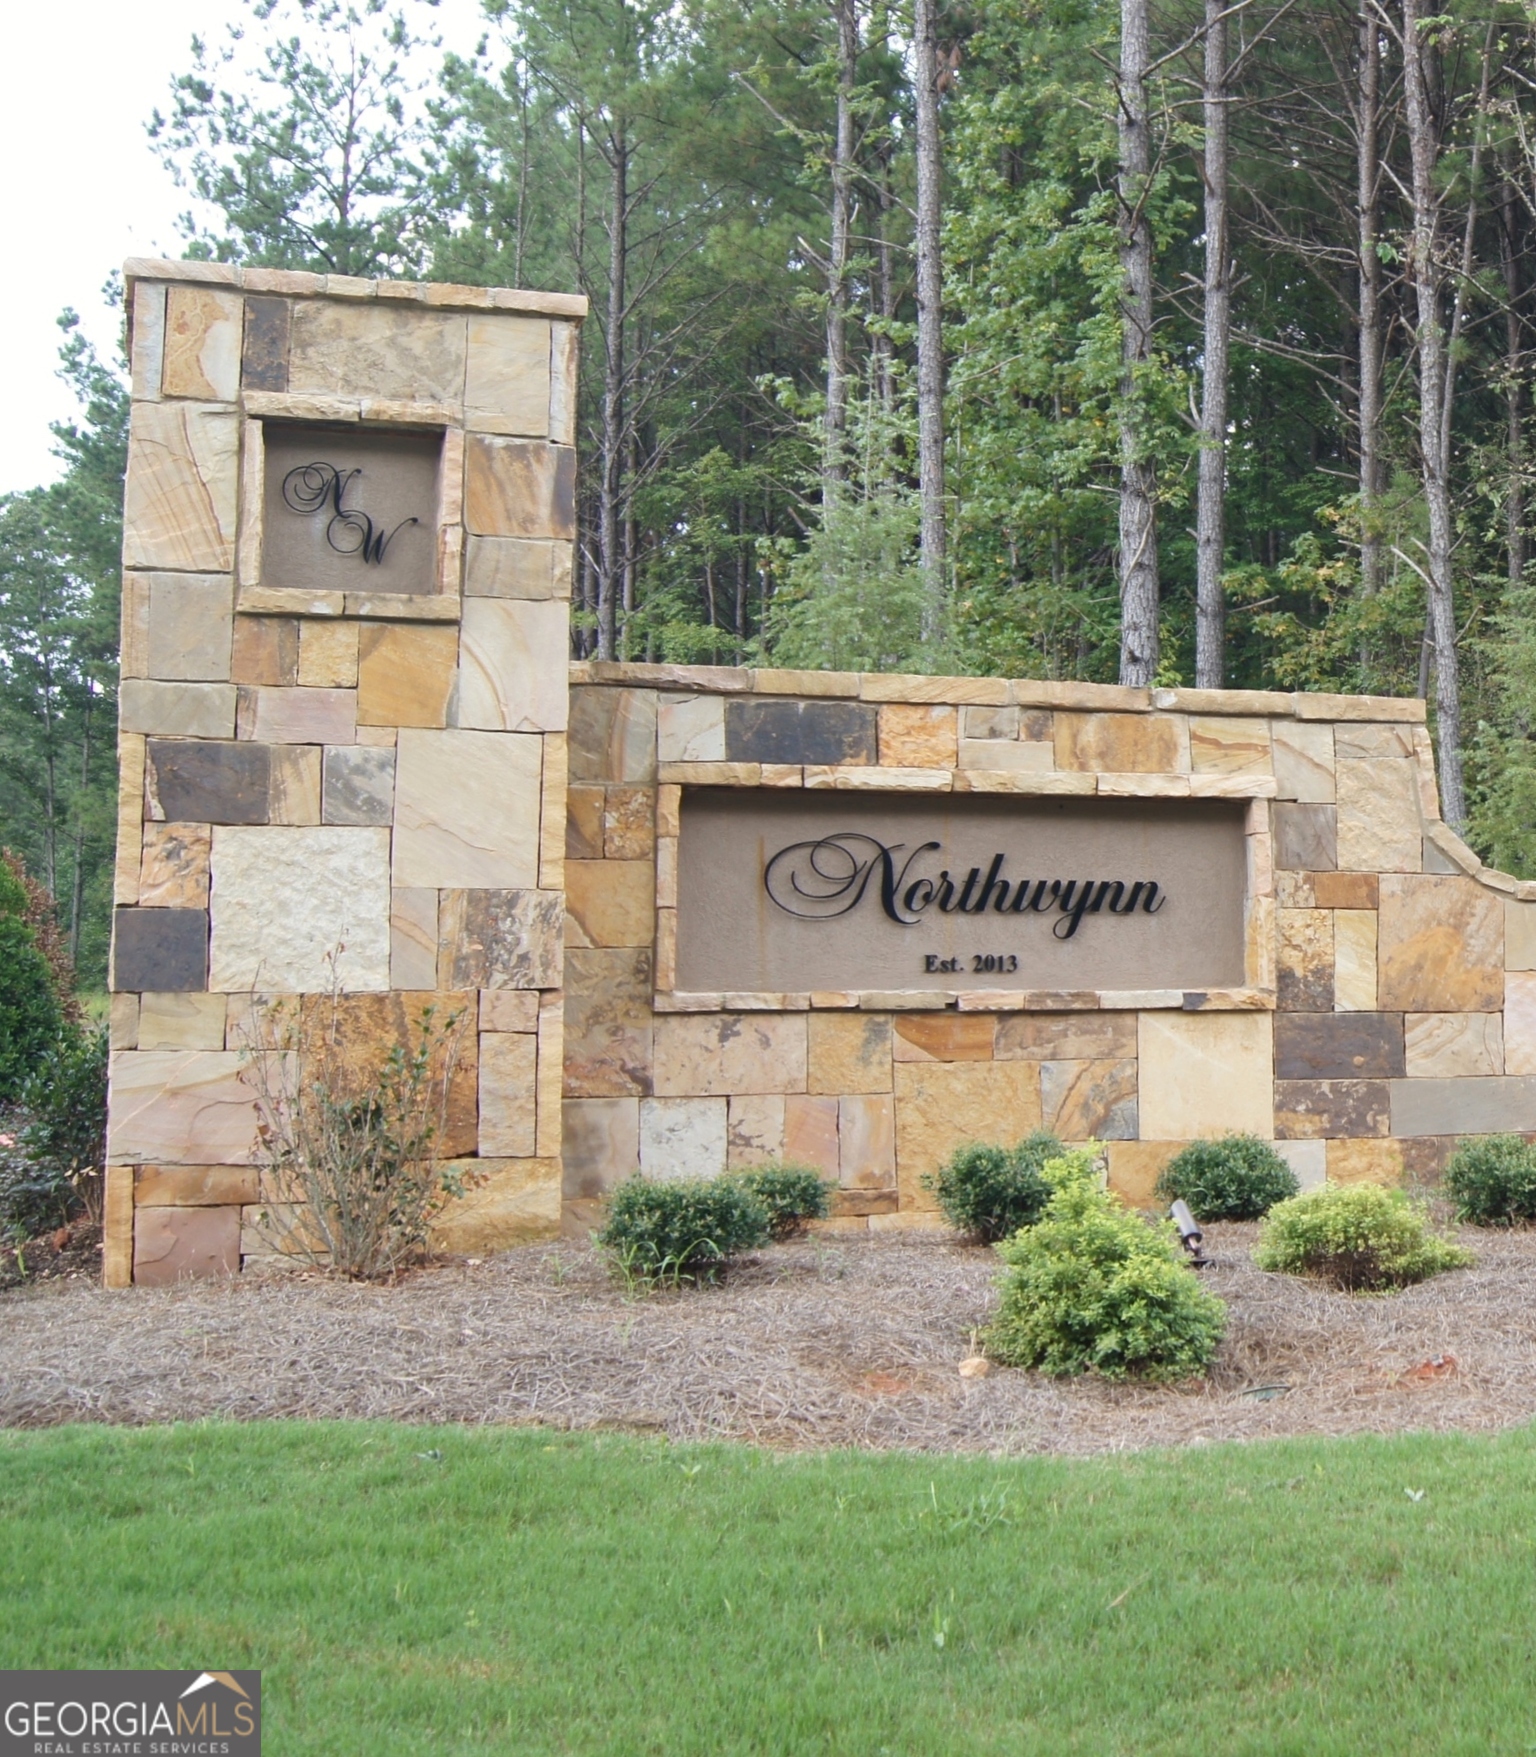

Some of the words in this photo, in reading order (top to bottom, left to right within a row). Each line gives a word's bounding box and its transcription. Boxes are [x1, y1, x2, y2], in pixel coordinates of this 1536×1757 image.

[764, 832, 1167, 940] Northwynn
[924, 954, 964, 973] Est.
[972, 954, 1018, 973] 2013
